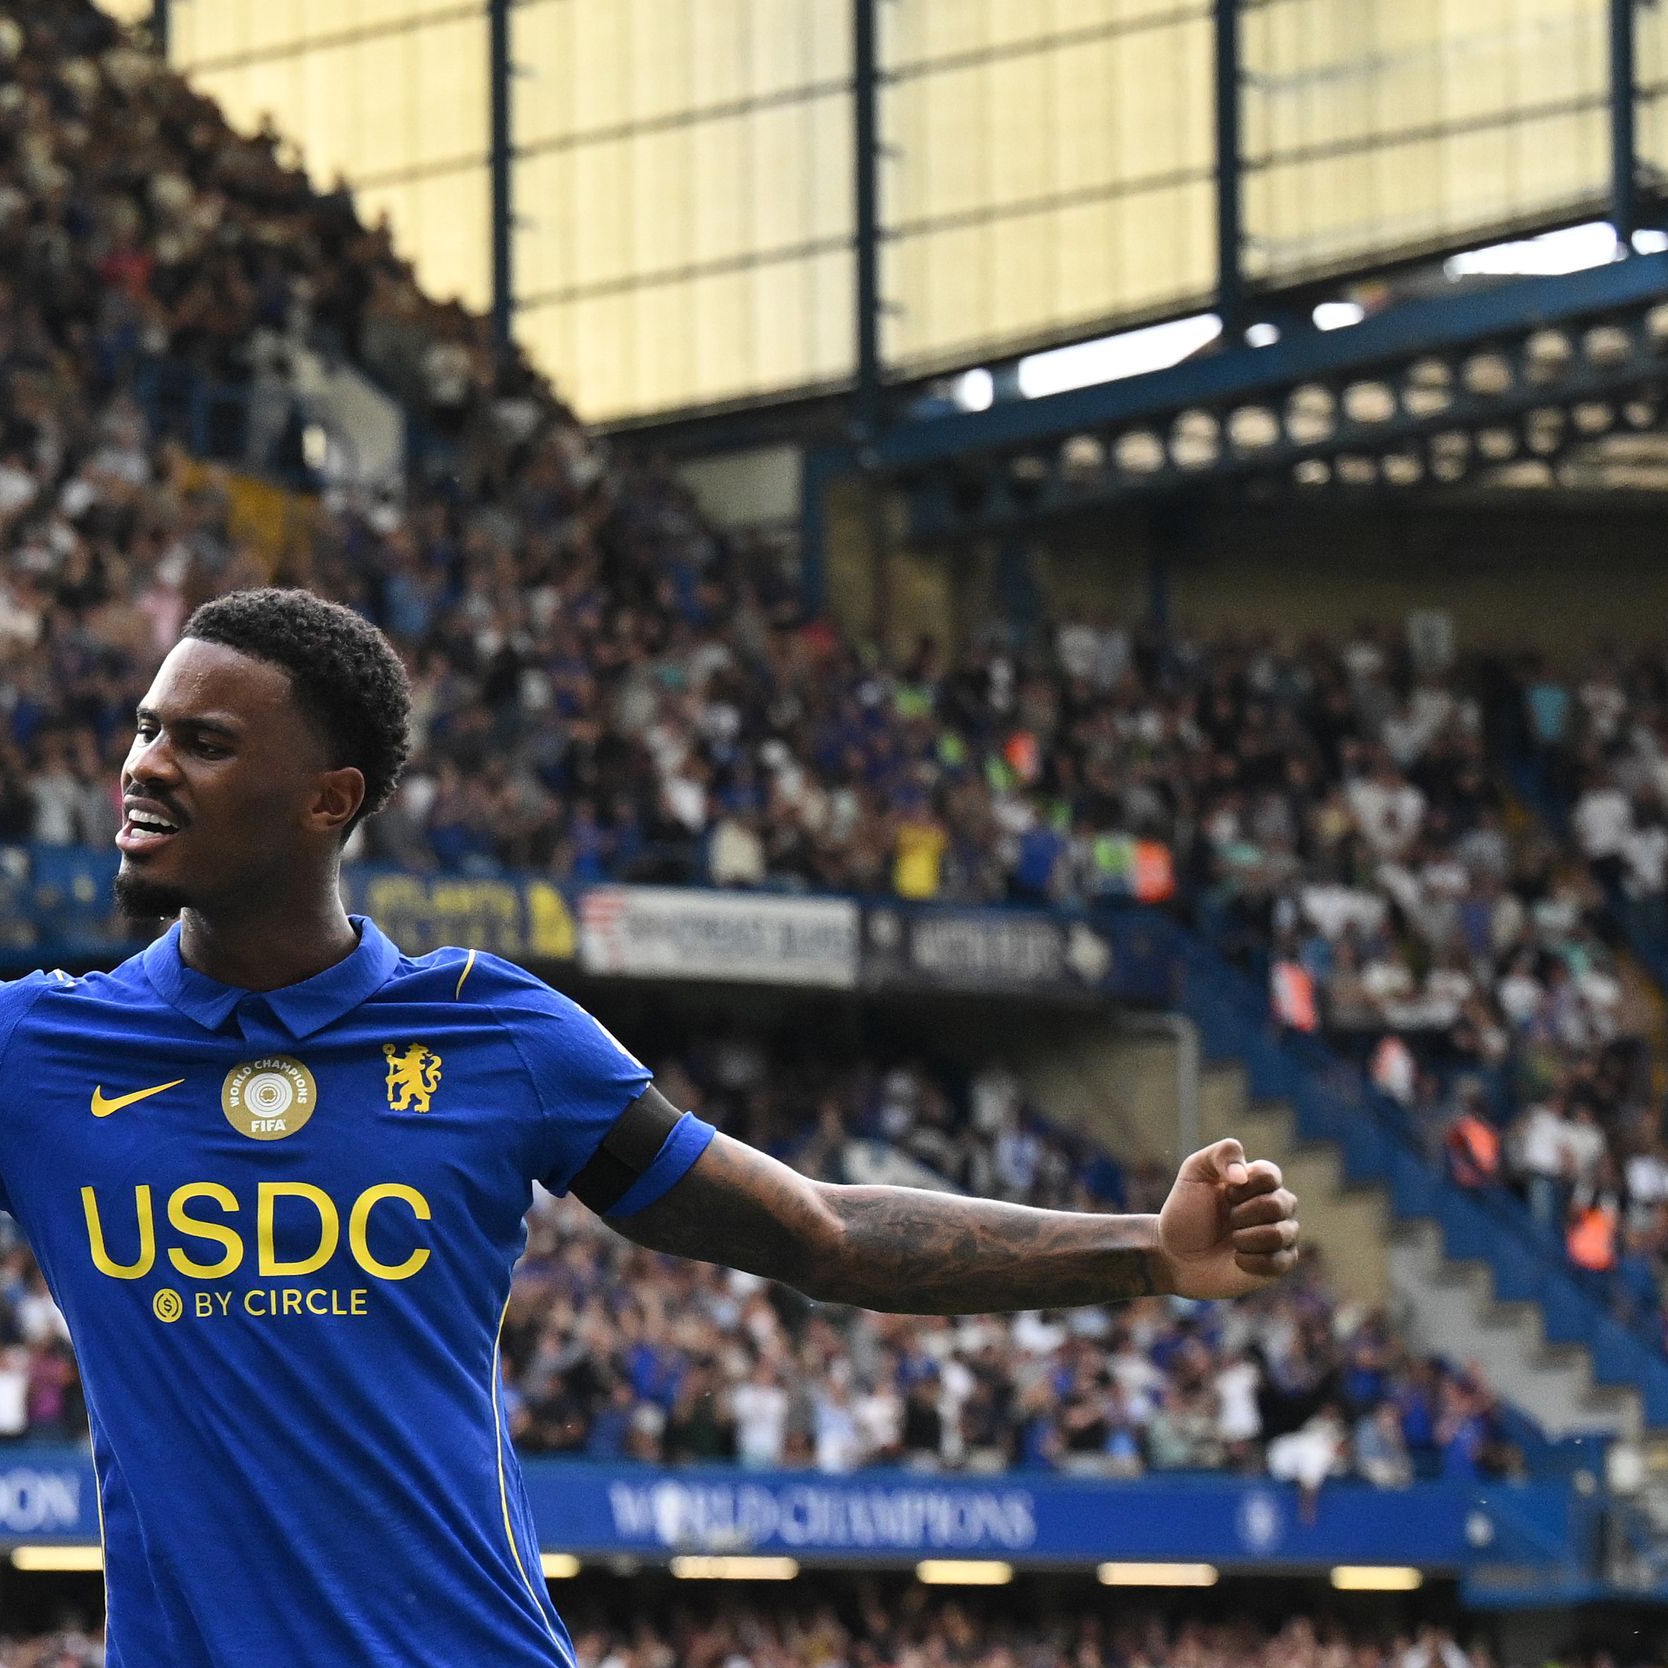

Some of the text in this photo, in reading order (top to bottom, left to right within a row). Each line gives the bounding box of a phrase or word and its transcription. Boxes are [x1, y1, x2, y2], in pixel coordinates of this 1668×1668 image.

[229, 1059, 308, 1108] WORLD CHAMPIONS
[251, 1119, 286, 1133] FIFA
[81, 1181, 432, 1281] USDC
[195, 1287, 368, 1318] BY CIRCLE
